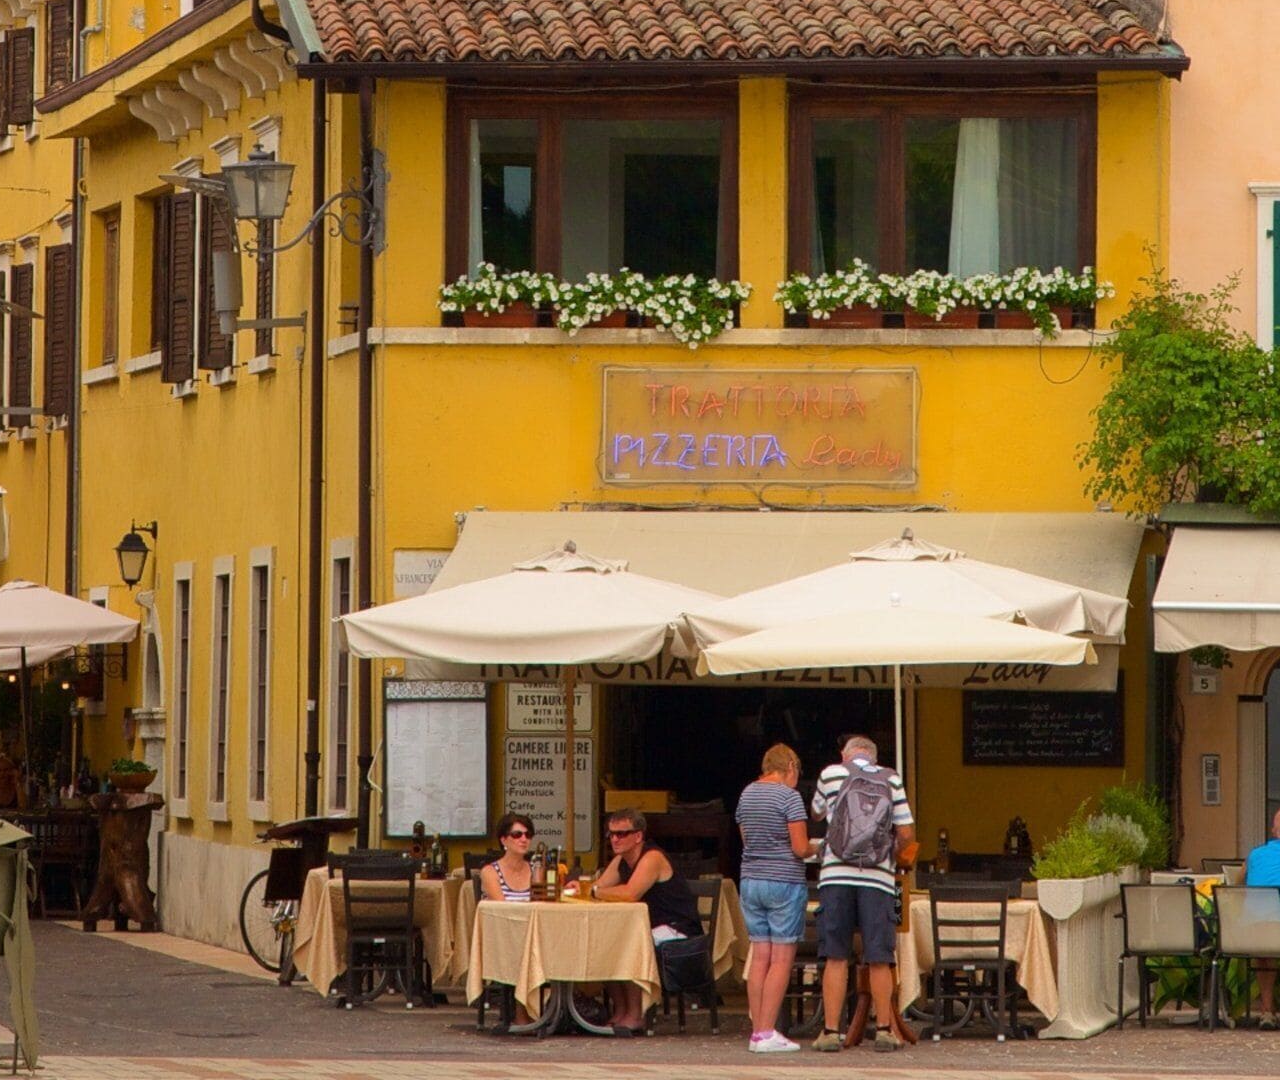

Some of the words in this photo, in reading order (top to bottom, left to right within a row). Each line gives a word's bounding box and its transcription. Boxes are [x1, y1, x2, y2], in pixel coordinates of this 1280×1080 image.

[645, 384, 866, 418] TRATTORIA
[613, 433, 788, 470] PIZZERIA
[802, 433, 902, 473] Lady
[1200, 678, 1209, 690] 5
[517, 695, 582, 706] RESTAURAT
[533, 708, 552, 716] WITH
[508, 742, 550, 755] CAMERE
[554, 742, 590, 755] LIERE
[511, 758, 554, 771] ZIMMER
